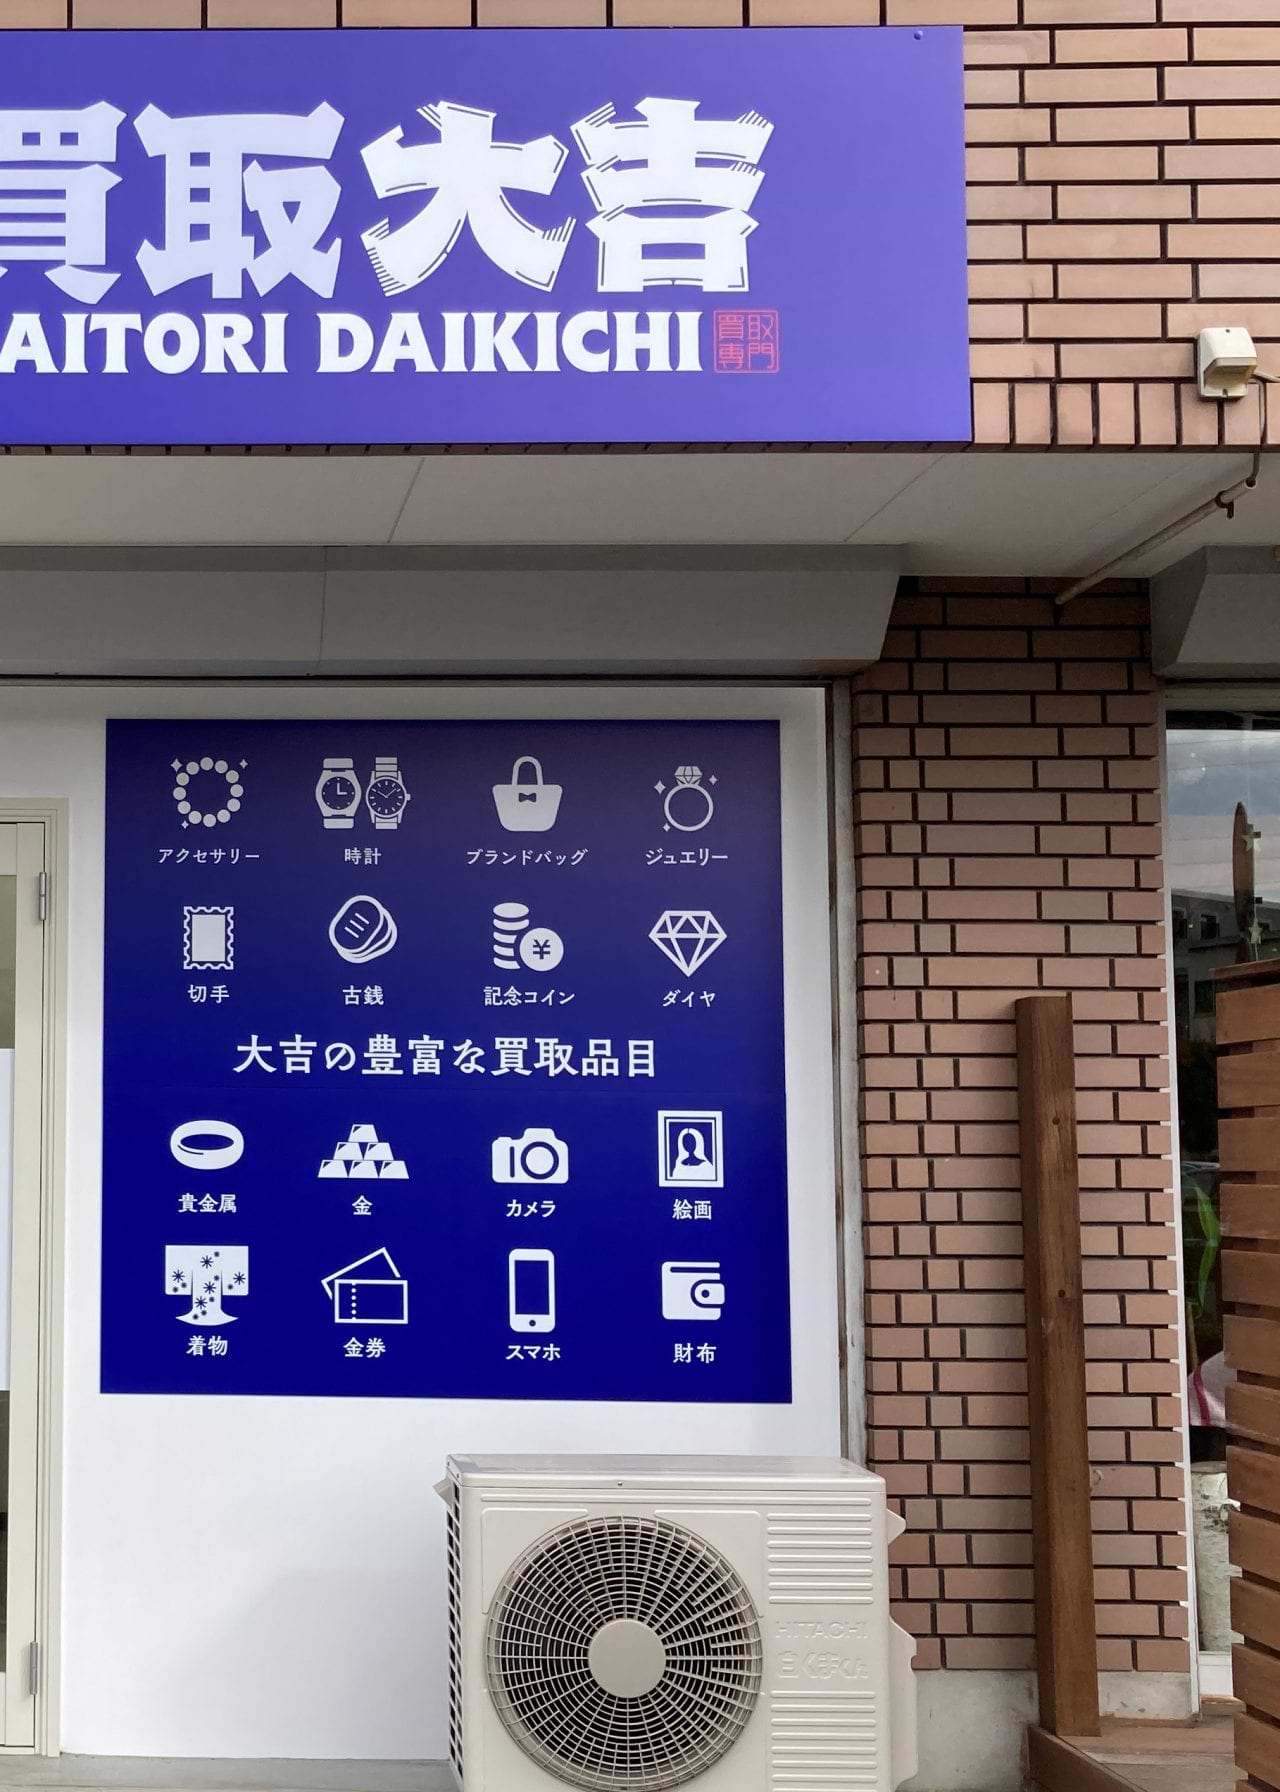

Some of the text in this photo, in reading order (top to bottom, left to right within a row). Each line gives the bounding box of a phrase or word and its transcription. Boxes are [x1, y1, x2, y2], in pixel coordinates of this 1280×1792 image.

[316, 310, 704, 374] DAIKICHI
[158, 848, 261, 866] アクセサリー
[343, 847, 383, 866] 時計
[467, 848, 589, 867] ブランドバッグ
[645, 847, 730, 867] ジュエリー
[187, 984, 231, 1005] 切手
[342, 984, 385, 1007] 古銭
[483, 985, 576, 1007] 記念コイン
[662, 989, 717, 1009] ダイヤ
[233, 1033, 656, 1079] 大吉の豊富な買取品目
[178, 1192, 237, 1214] 貴金属
[351, 1195, 373, 1217] 金
[505, 1199, 557, 1219] カメラ
[672, 1198, 713, 1221] 絵画
[186, 1335, 229, 1357] 着物
[343, 1336, 387, 1359] 金券
[505, 1342, 562, 1362] スマホ
[672, 1342, 718, 1364] 財布
[775, 1620, 869, 1640] HITACHI
